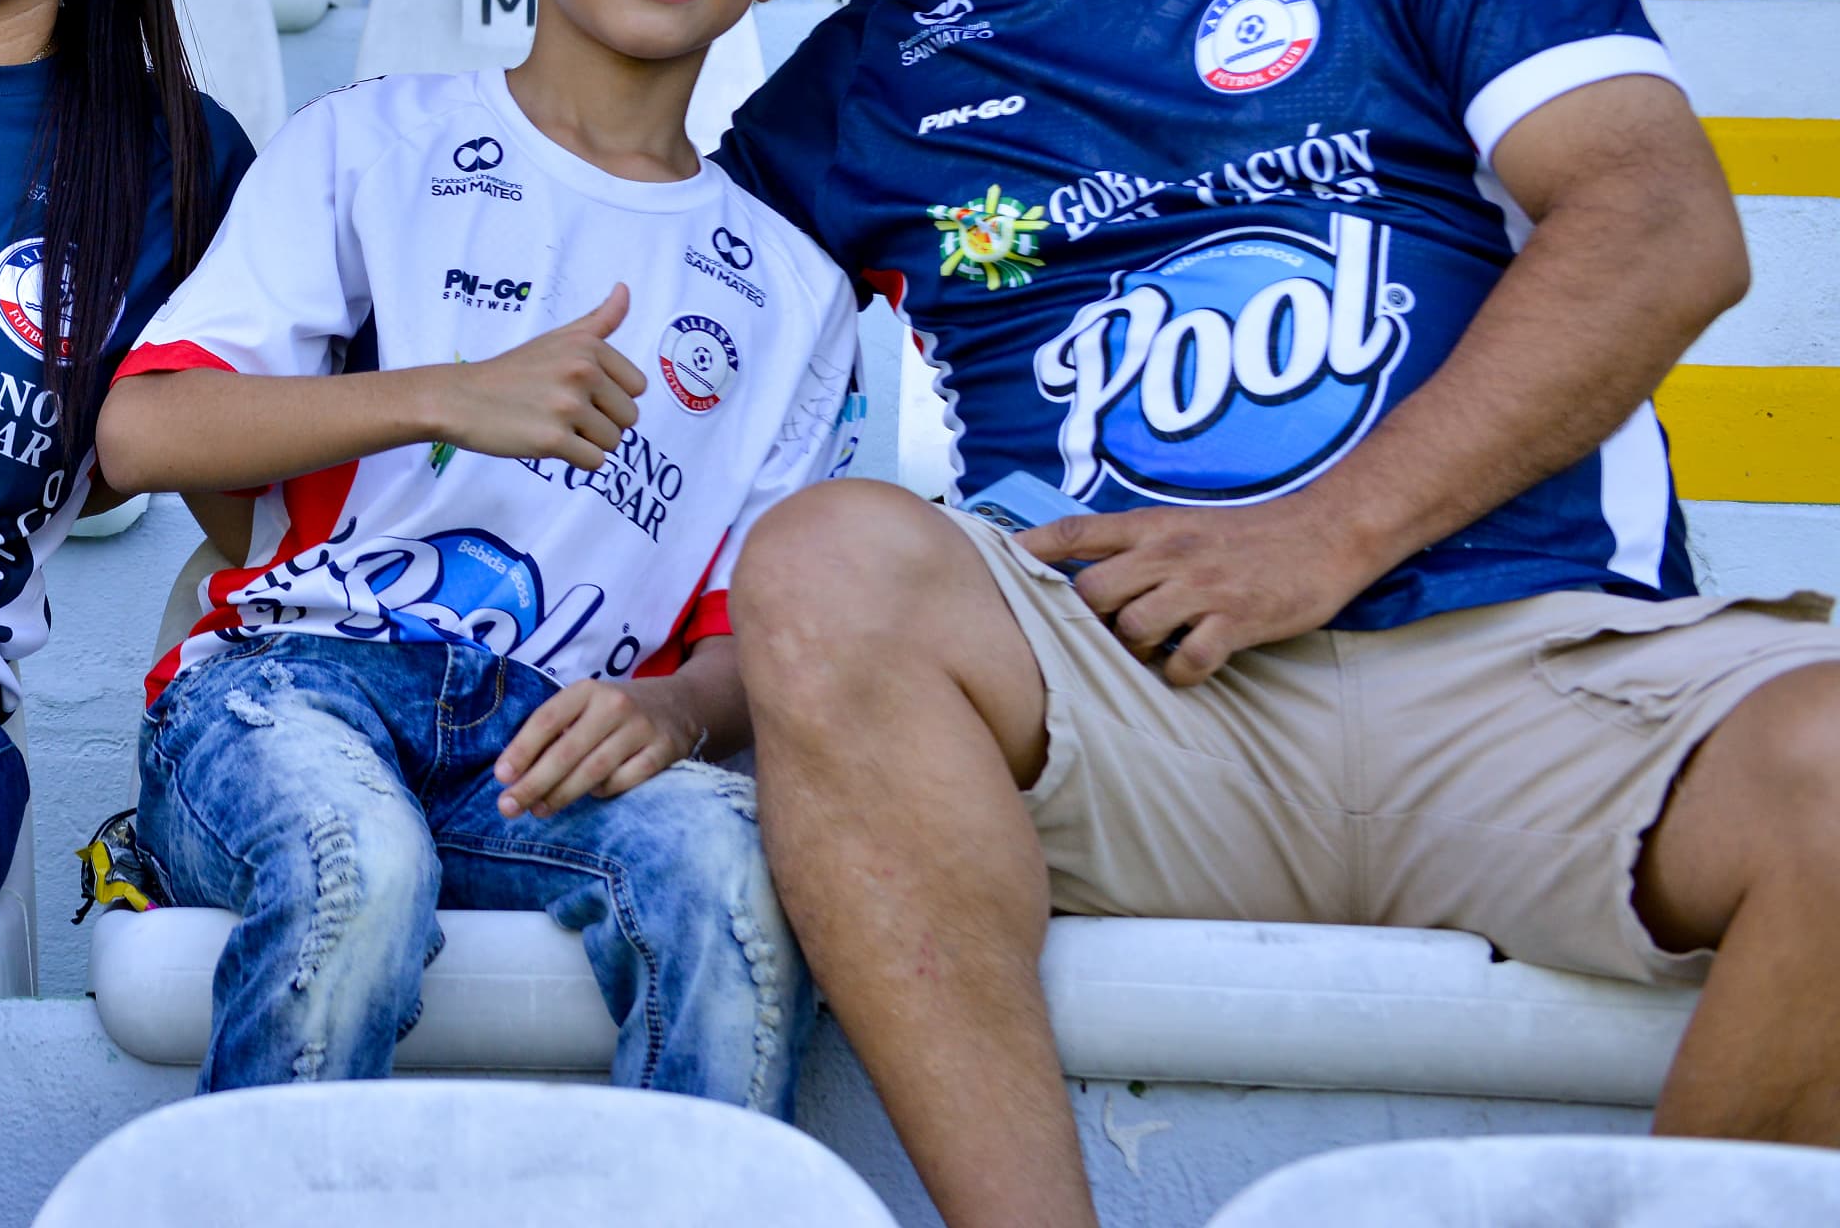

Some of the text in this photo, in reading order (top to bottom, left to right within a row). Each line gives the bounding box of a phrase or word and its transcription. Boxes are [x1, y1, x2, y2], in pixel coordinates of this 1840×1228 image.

[901, 42, 936, 66] SAN
[918, 95, 1026, 135] PIN-GO
[431, 180, 522, 202] SAN MATEO
[684, 252, 716, 277] SAN
[717, 270, 764, 308] MATEO
[1035, 213, 1400, 500] Pool
[457, 539, 507, 575] Bebida
